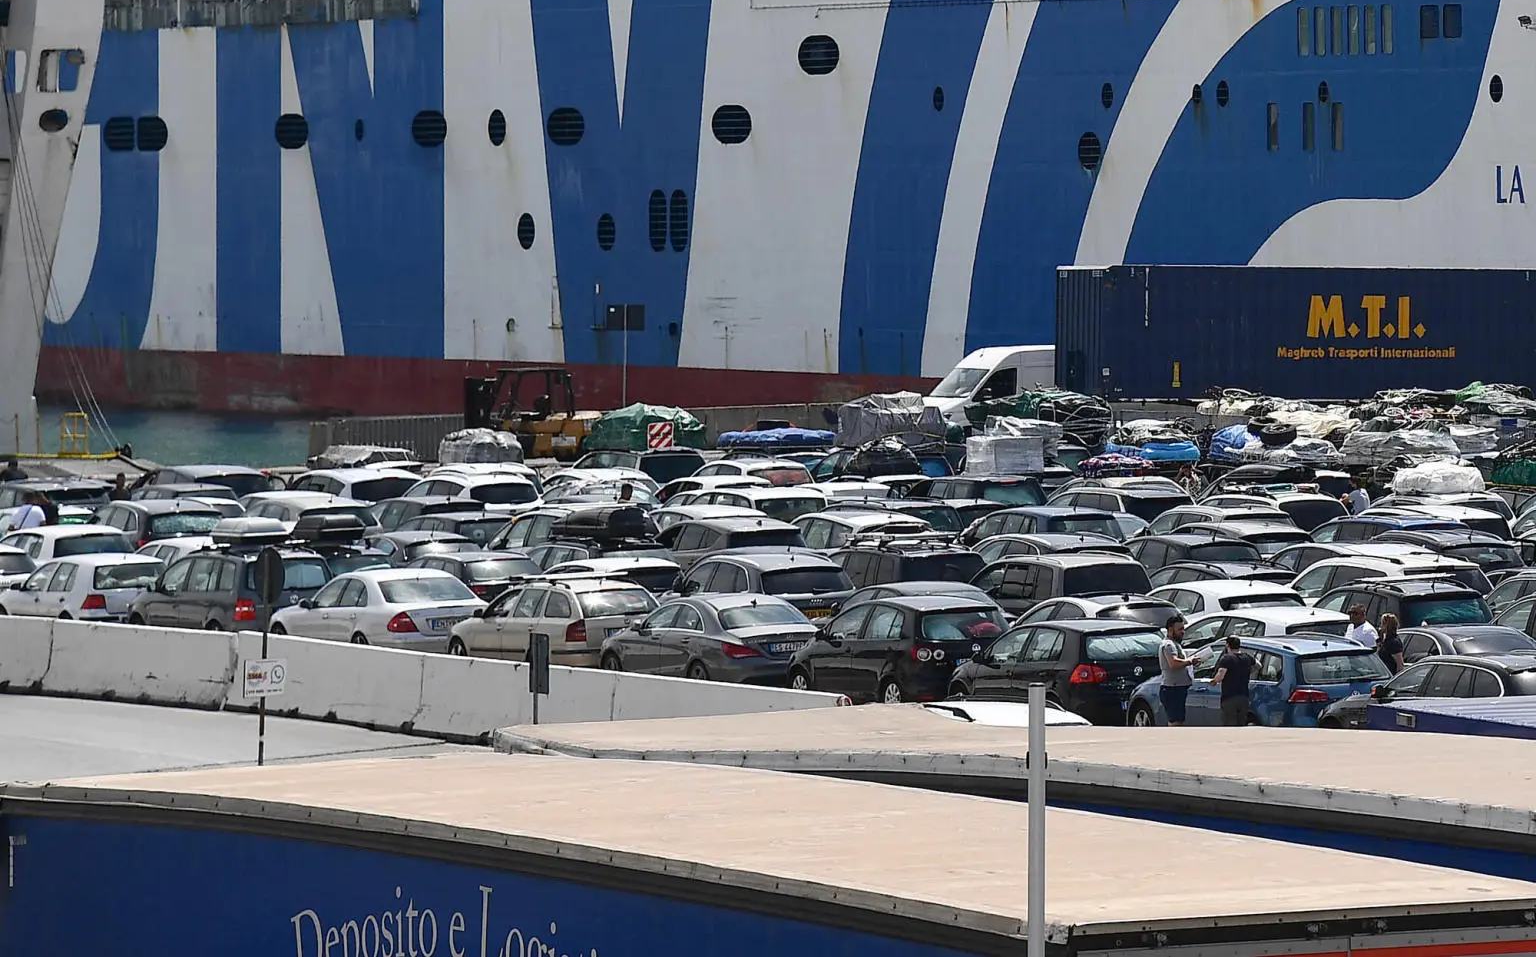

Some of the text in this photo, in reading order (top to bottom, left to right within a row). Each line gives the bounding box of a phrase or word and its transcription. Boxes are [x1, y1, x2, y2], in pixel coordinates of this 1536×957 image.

[1496, 165, 1526, 204] LA
[1307, 295, 1426, 338] M.T.I.
[1277, 346, 1456, 360] Maghreb Trasporti Internazionali
[449, 910, 465, 957] e
